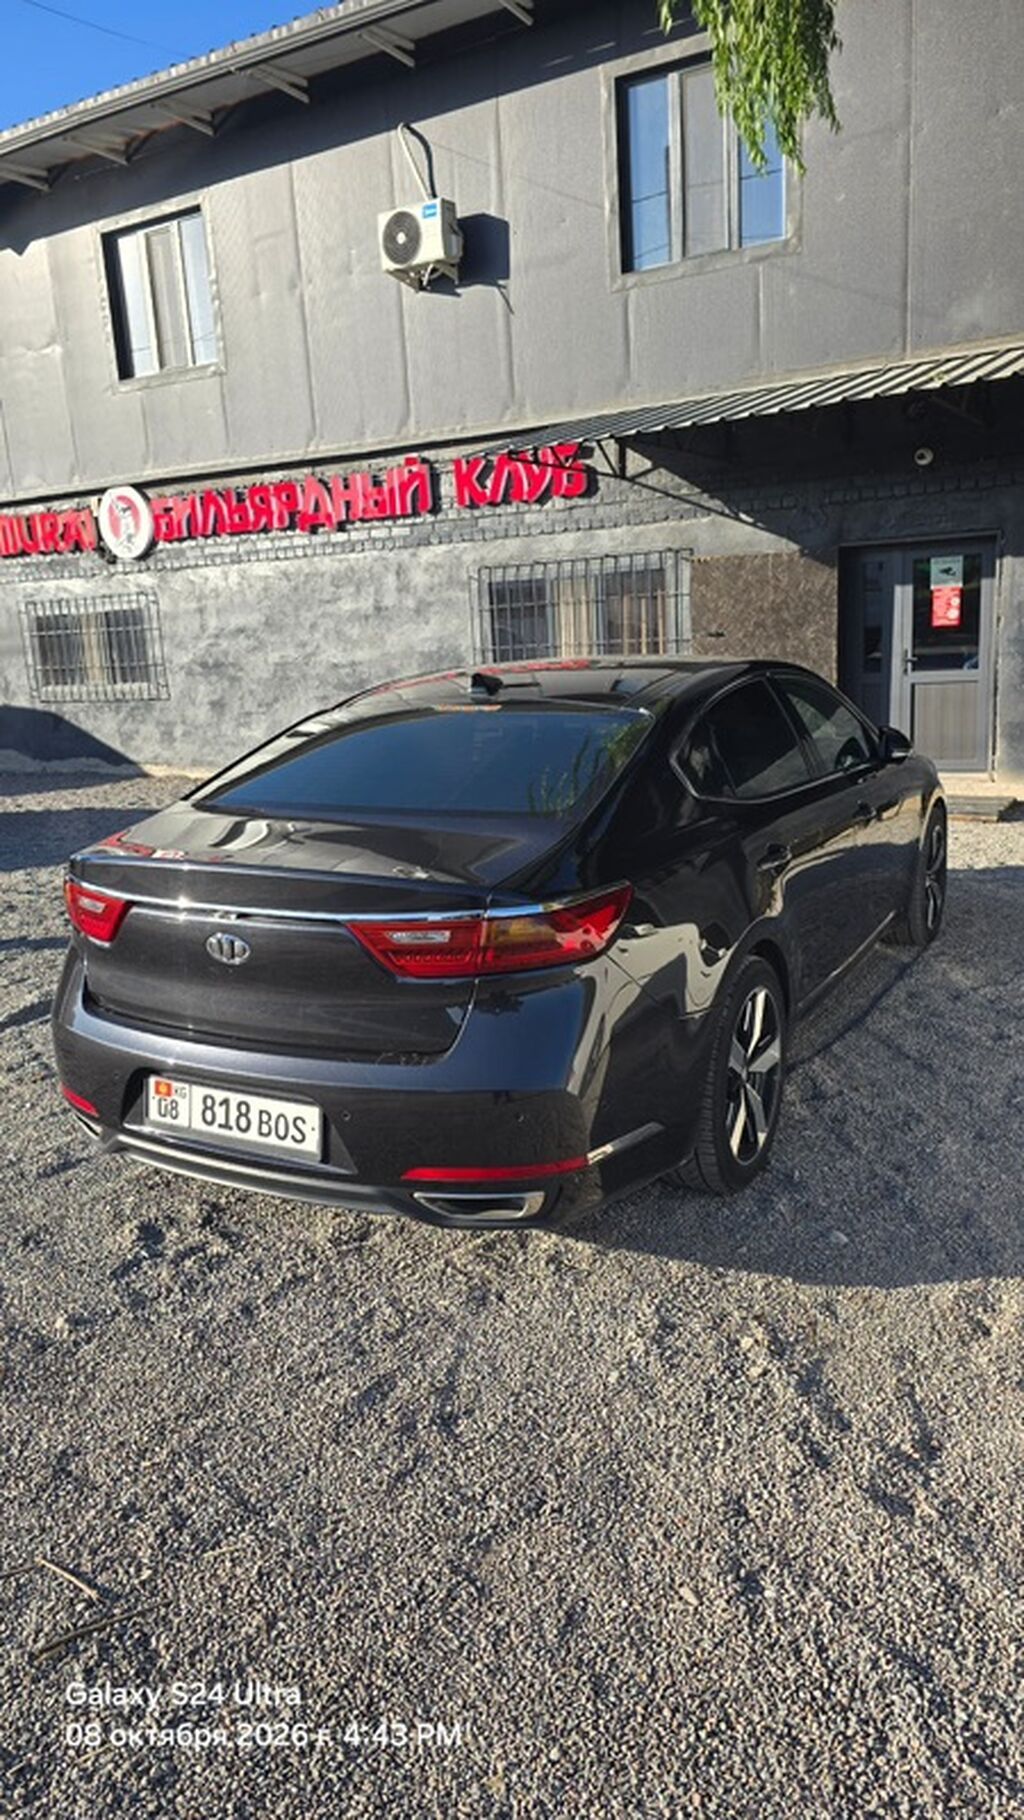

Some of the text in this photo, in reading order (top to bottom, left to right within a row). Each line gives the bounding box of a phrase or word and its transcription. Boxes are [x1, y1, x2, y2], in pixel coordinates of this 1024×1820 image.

[151, 441, 588, 542] БИЛЬЯРДНЫЙ КЛУБ
[201, 1094, 251, 1134] 818
[258, 1109, 307, 1144] BOS
